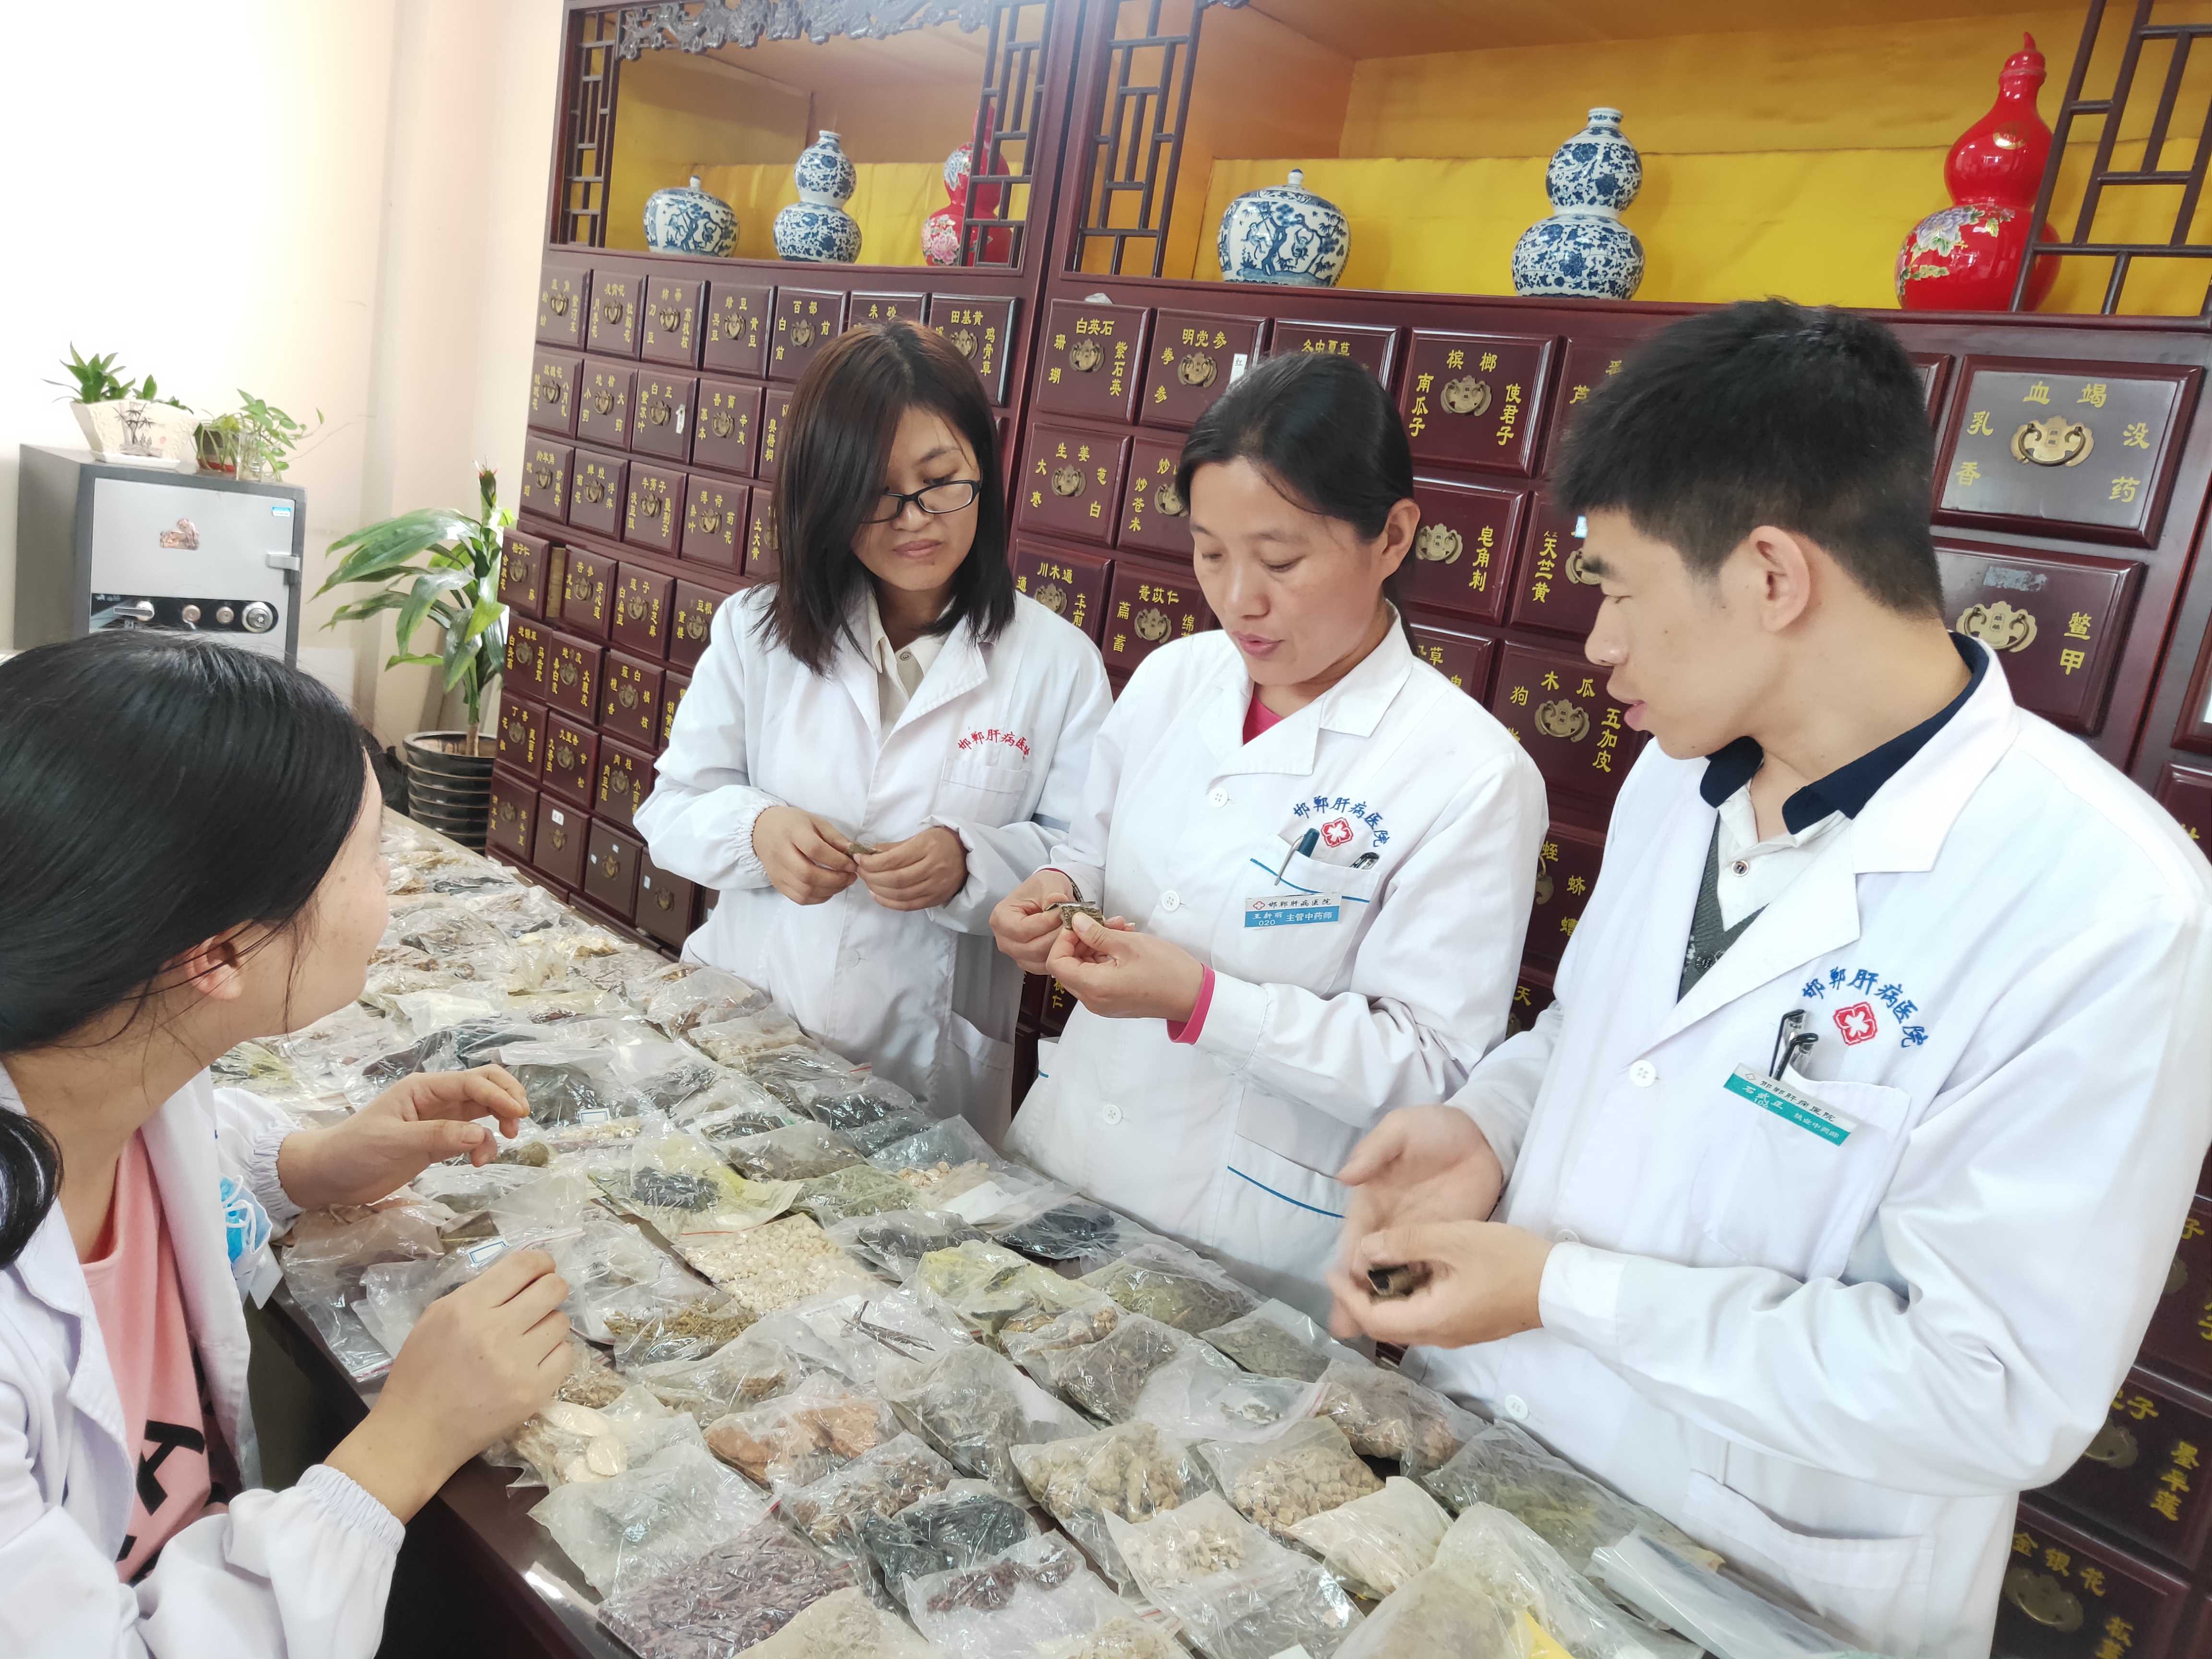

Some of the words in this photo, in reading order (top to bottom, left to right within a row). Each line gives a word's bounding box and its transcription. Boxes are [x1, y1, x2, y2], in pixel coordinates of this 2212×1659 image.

[726, 297, 748, 311] 绿豆
[793, 300, 818, 315] 百部
[869, 304, 898, 320] 朱砂
[951, 310, 984, 326] 田基黄
[749, 316, 760, 349] 黄豆
[775, 317, 788, 361] 白前
[1075, 318, 1115, 337] 白英石
[1182, 327, 1227, 350] 明党参
[980, 327, 996, 377] 鸡骨草
[1049, 334, 1067, 384] 珊瑚
[1110, 341, 1128, 396] 紫石英
[1446, 349, 1499, 373] 槟榔
[1408, 373, 1435, 438] 南瓜子
[1494, 384, 1522, 446] 使君子
[2022, 381, 2108, 409] 血竭
[1055, 443, 1090, 462] 生姜
[1956, 410, 1995, 487] 乳香
[2109, 421, 2151, 504] 没药
[642, 477, 666, 493] 牛蒡子
[700, 491, 723, 508] 薄荷
[1030, 458, 1048, 508] 大枣
[1129, 478, 1148, 531] 炒苍术
[724, 511, 734, 544] 菊花
[752, 518, 762, 560] 土大黄
[1037, 562, 1073, 585] 川木通
[1469, 526, 1494, 592] 皂角刺
[1532, 537, 1558, 604] 天竺黄
[690, 599, 713, 615] 豆根
[1139, 583, 1180, 604] 薏苡仁
[1113, 601, 1130, 654] 萹蓄
[2058, 611, 2092, 677] 鳖甲
[561, 647, 582, 664] 地皮
[1540, 670, 1596, 699] 木瓜
[1591, 707, 1622, 774] 五加皮
[1293, 795, 1390, 847] 邯郸肝病医院
[1268, 898, 1331, 909] 邯郸肝病医院
[1286, 911, 1333, 922] 主管中药师
[1802, 966, 1929, 1048] 邯郸肝病医院
[1760, 1081, 1836, 1122] 邯郸肝病医院
[2149, 1440, 2200, 1522] 墨旱莲
[2011, 1532, 2106, 1598] 金银花
